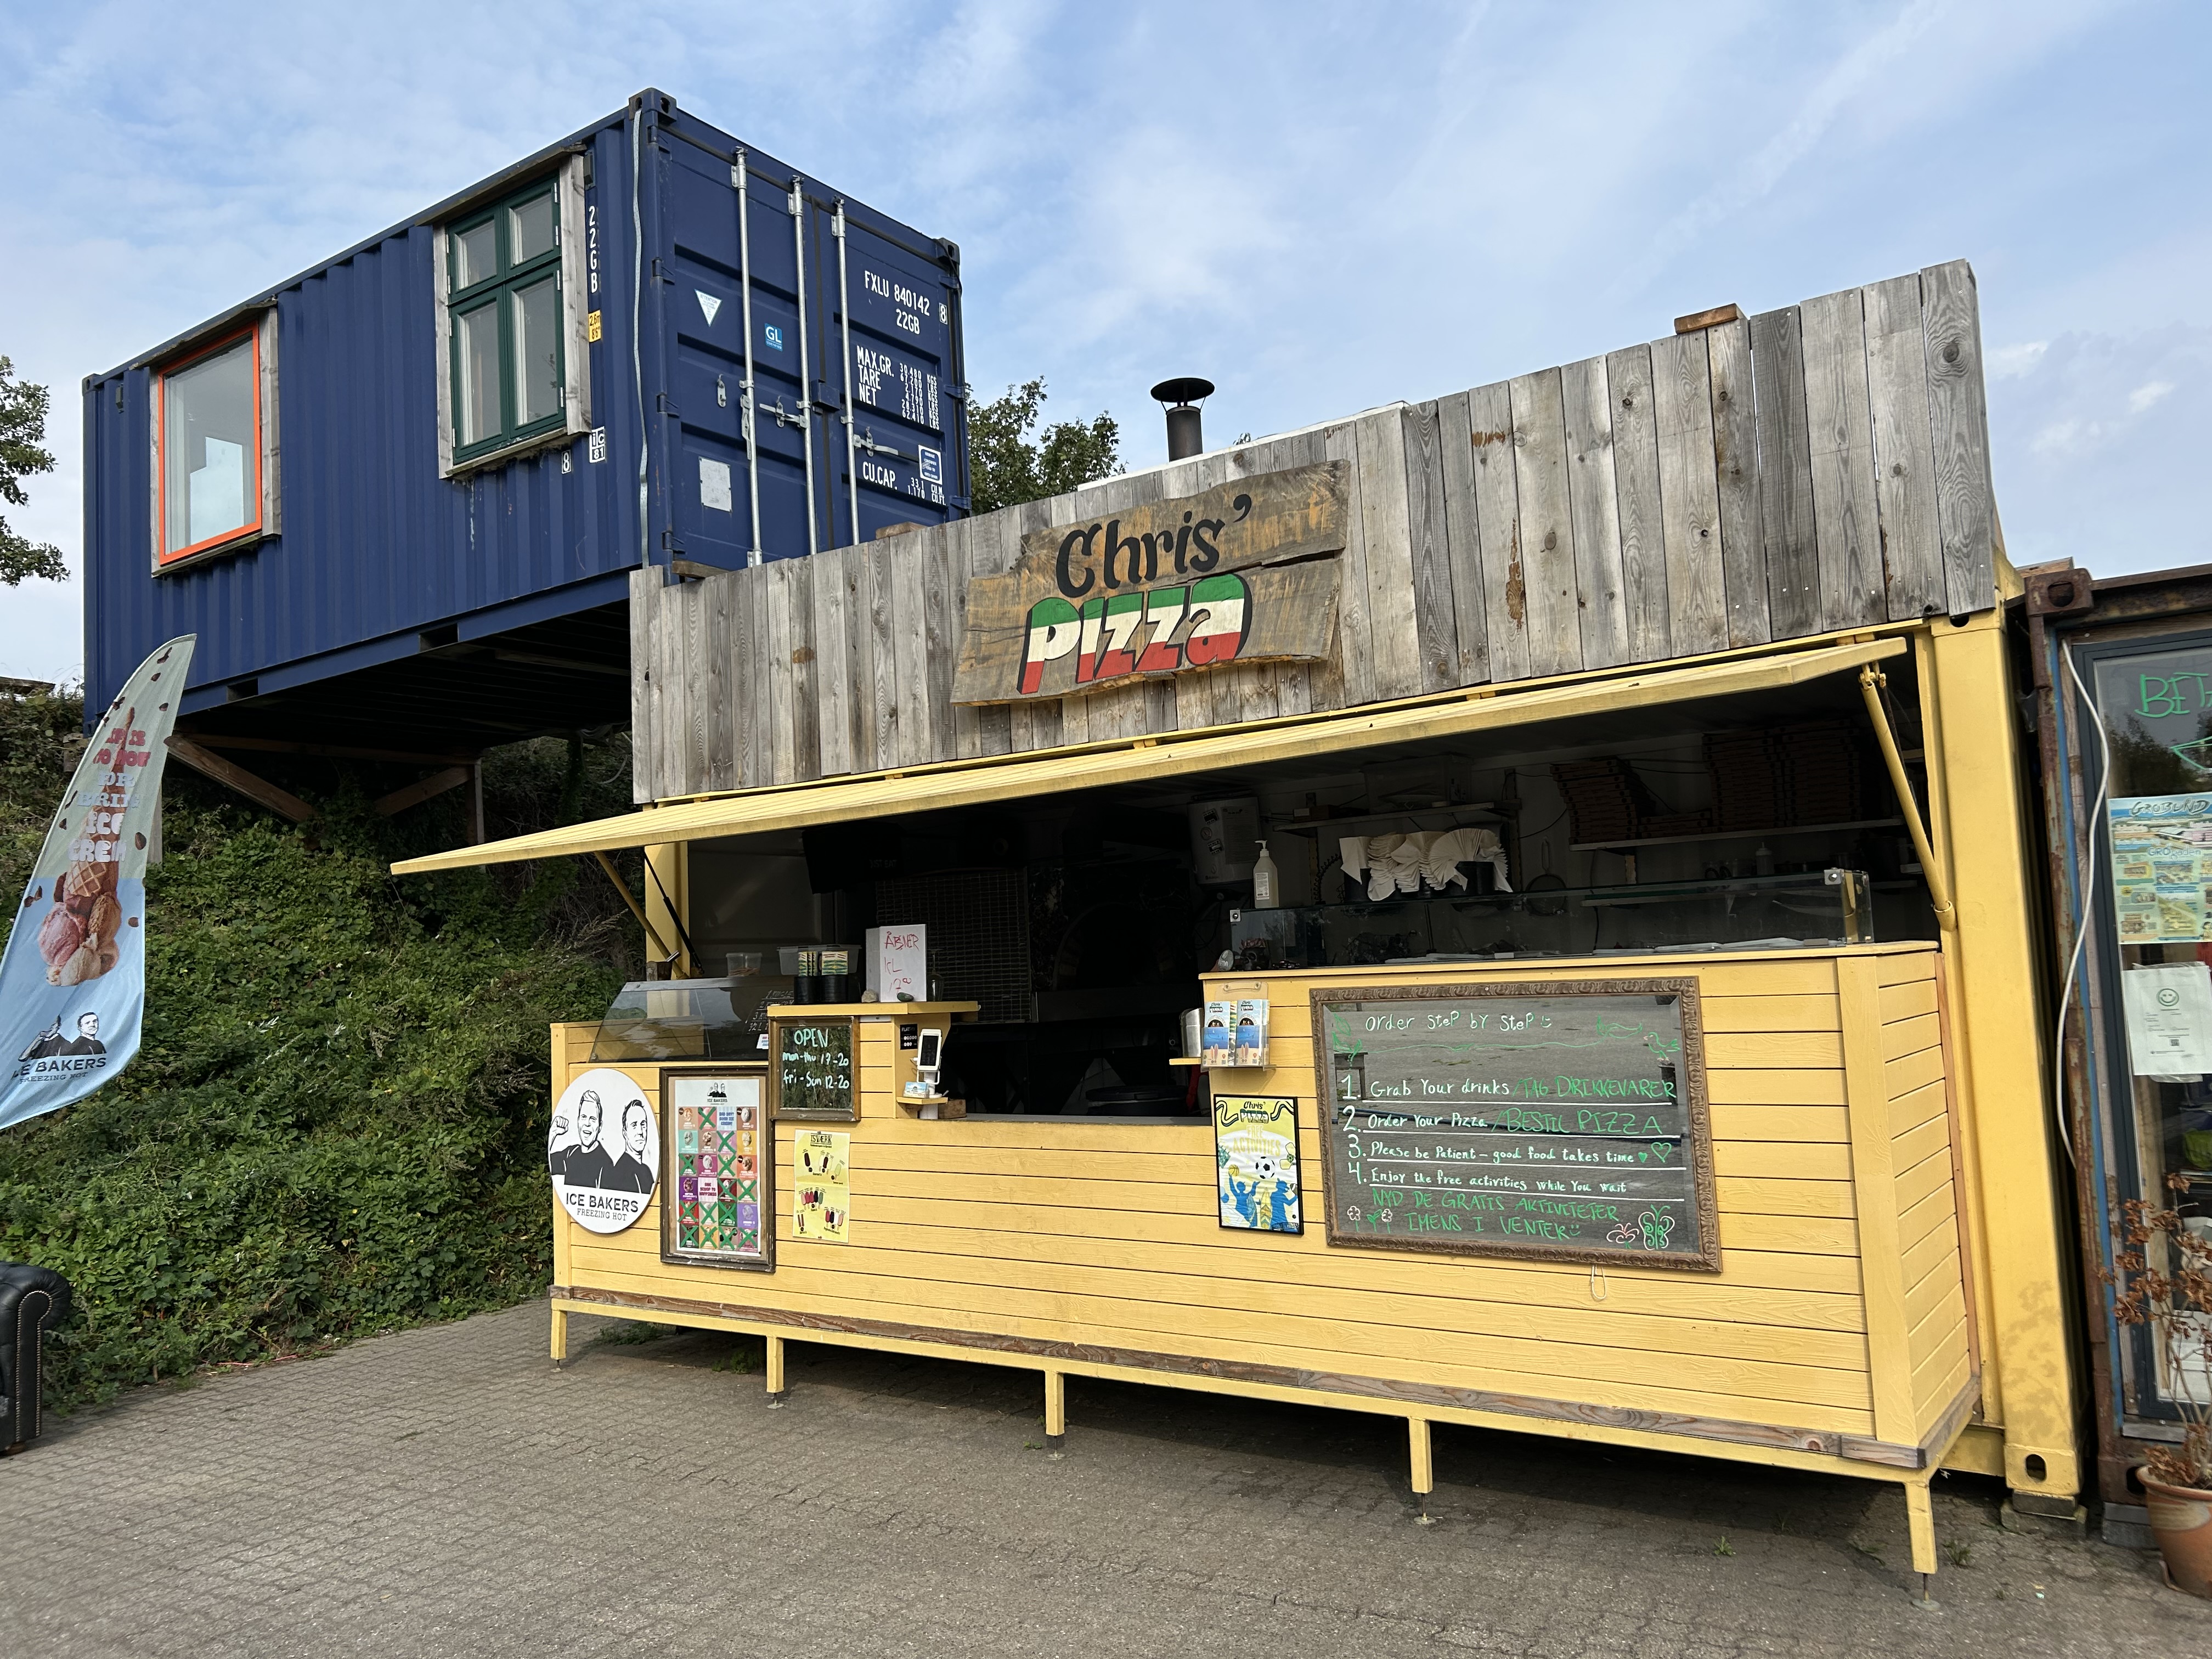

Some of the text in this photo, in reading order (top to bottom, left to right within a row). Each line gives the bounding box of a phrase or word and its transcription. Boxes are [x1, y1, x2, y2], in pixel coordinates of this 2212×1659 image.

[865, 270, 946, 322] FXLU 840142 8
[896, 308, 920, 335] 22GB
[766, 326, 781, 343] GL
[857, 345, 936, 386] MAX.GR. 30.480 KGS
[858, 364, 882, 390] TARE
[927, 383, 937, 395] LBS
[859, 382, 877, 406] NET
[928, 392, 938, 404] KGS
[929, 410, 939, 421] KGS
[563, 452, 569, 471] 8
[594, 448, 603, 459] 81
[863, 461, 898, 490] CU.CAP.
[1056, 494, 1252, 598] Chris'
[2134, 672, 2212, 718] BET
[794, 1028, 829, 1048] OPEN
[35, 1057, 106, 1073] BAKERS
[1341, 1074, 1361, 1100] 1.
[1370, 1080, 1412, 1097] Grab
[1420, 1079, 1454, 1095] Your
[1462, 1078, 1509, 1095] drinks
[1246, 1124, 1264, 1138] FREE
[1342, 1105, 1361, 1132] 2.
[1368, 1114, 1408, 1129] Order
[1413, 1114, 1443, 1128] Your
[1451, 1112, 1488, 1128] Pizza
[1577, 1109, 1663, 1135] PIZZA
[1348, 1133, 1367, 1159] 3.
[1371, 1141, 1409, 1157] Please
[1415, 1147, 1430, 1159] be
[1435, 1146, 1476, 1159] Patient
[1493, 1147, 1522, 1164] good
[1528, 1146, 1556, 1160] food
[1562, 1149, 1600, 1163] takes
[1606, 1152, 1634, 1163] time
[1347, 1161, 1367, 1184] 4.
[1414, 1172, 1431, 1183] the
[1436, 1169, 1462, 1185] free
[1469, 1175, 1527, 1191] activities
[1571, 1180, 1592, 1192] You
[1599, 1182, 1627, 1193] wait
[566, 1192, 639, 1212] ICE BAKERS
[1372, 1187, 1403, 1208] NYD
[1412, 1191, 1434, 1209] DE
[1441, 1190, 1505, 1211] GRATIS
[577, 1207, 627, 1221] FREEZING HOT
[1404, 1212, 1462, 1232] IMENS
[1499, 1216, 1571, 1242] VENTER
